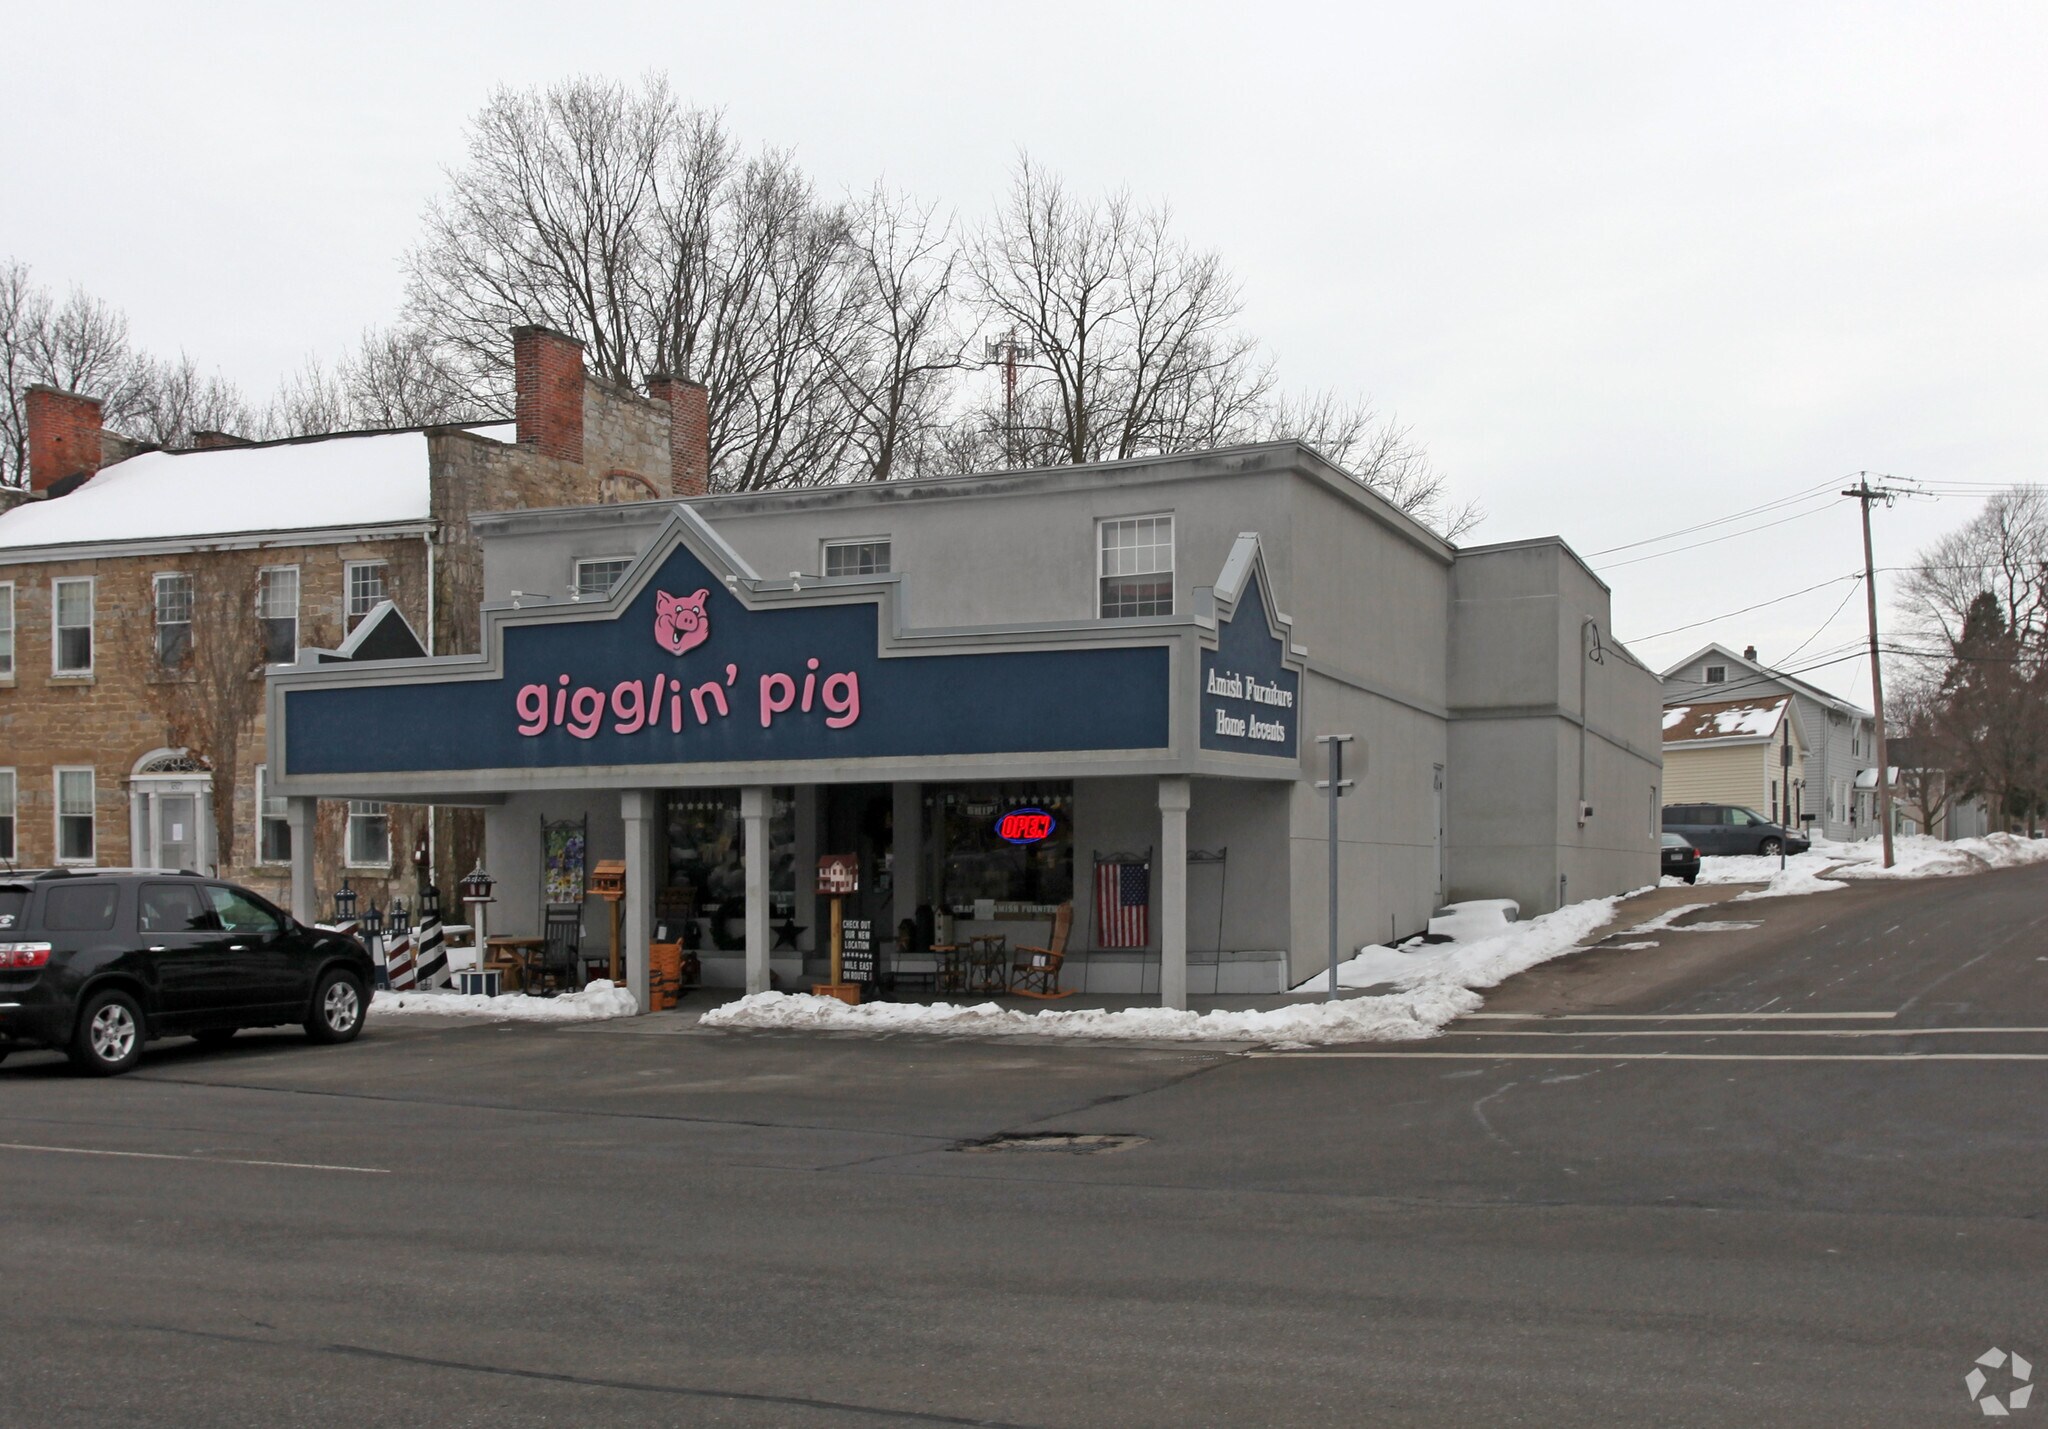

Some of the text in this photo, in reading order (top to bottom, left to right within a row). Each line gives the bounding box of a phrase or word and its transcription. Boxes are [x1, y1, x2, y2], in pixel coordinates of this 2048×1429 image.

[1207, 668, 1293, 708] Amish Furniture
[516, 657, 861, 739] gigglin' pig
[1215, 708, 1285, 742] Home Accents
[1001, 815, 1050, 839] OPEN
[842, 919, 871, 930] CHECK OUT
[845, 930, 871, 940] OUR NEW
[844, 941, 870, 950] LOCATION
[845, 961, 858, 970] MILE
[859, 961, 873, 971] EAST
[850, 971, 867, 981] ROUTE
